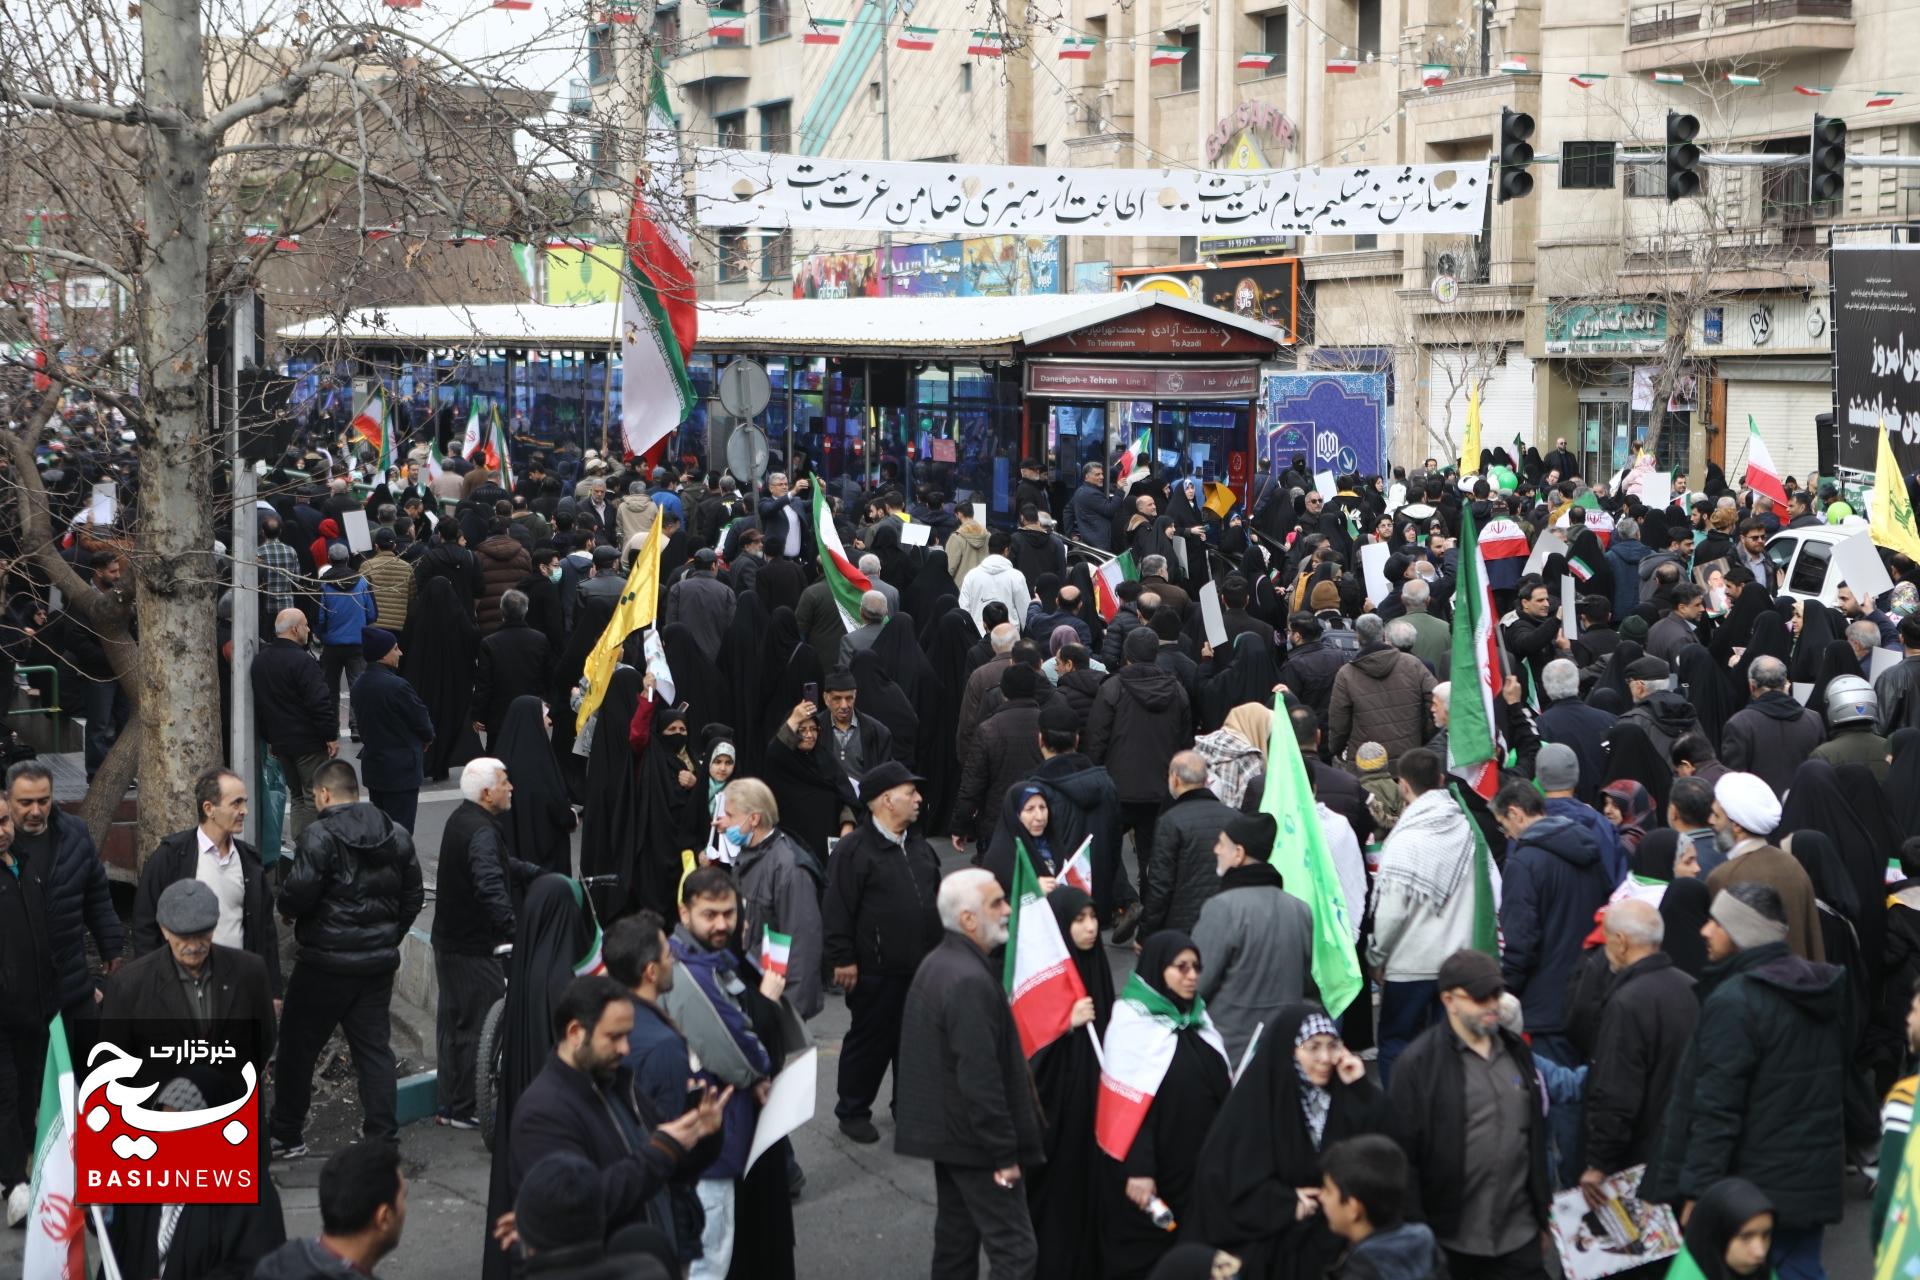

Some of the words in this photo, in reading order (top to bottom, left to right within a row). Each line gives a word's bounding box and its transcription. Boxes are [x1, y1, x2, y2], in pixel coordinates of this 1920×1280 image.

[1206, 118, 1232, 161] GO
[1236, 103, 1295, 149] SAFIR
[787, 164, 853, 211] ماست
[819, 173, 890, 221] عزت
[885, 173, 962, 225] ضامن
[1049, 174, 1073, 209] از
[1055, 187, 1148, 224] اطاعت
[1198, 177, 1259, 224] ماست
[1214, 188, 1268, 224] ملت
[1311, 168, 1370, 231] تسلیم
[1359, 182, 1381, 209] نه
[1376, 166, 1453, 225] سازش
[1449, 176, 1478, 211] نه
[963, 185, 1046, 228] رهبری
[1270, 183, 1315, 235] پیام
[1097, 340, 1136, 348] Tehranpars
[1152, 322, 1180, 337] آزادی
[1181, 339, 1202, 347] Azadi
[1182, 327, 1208, 335] سمت
[1210, 327, 1222, 336] به
[1871, 330, 1904, 378] امروز
[1040, 374, 1088, 384] Daneshgah-e
[1089, 375, 1118, 385] Tehran
[1126, 377, 1141, 385] Line
